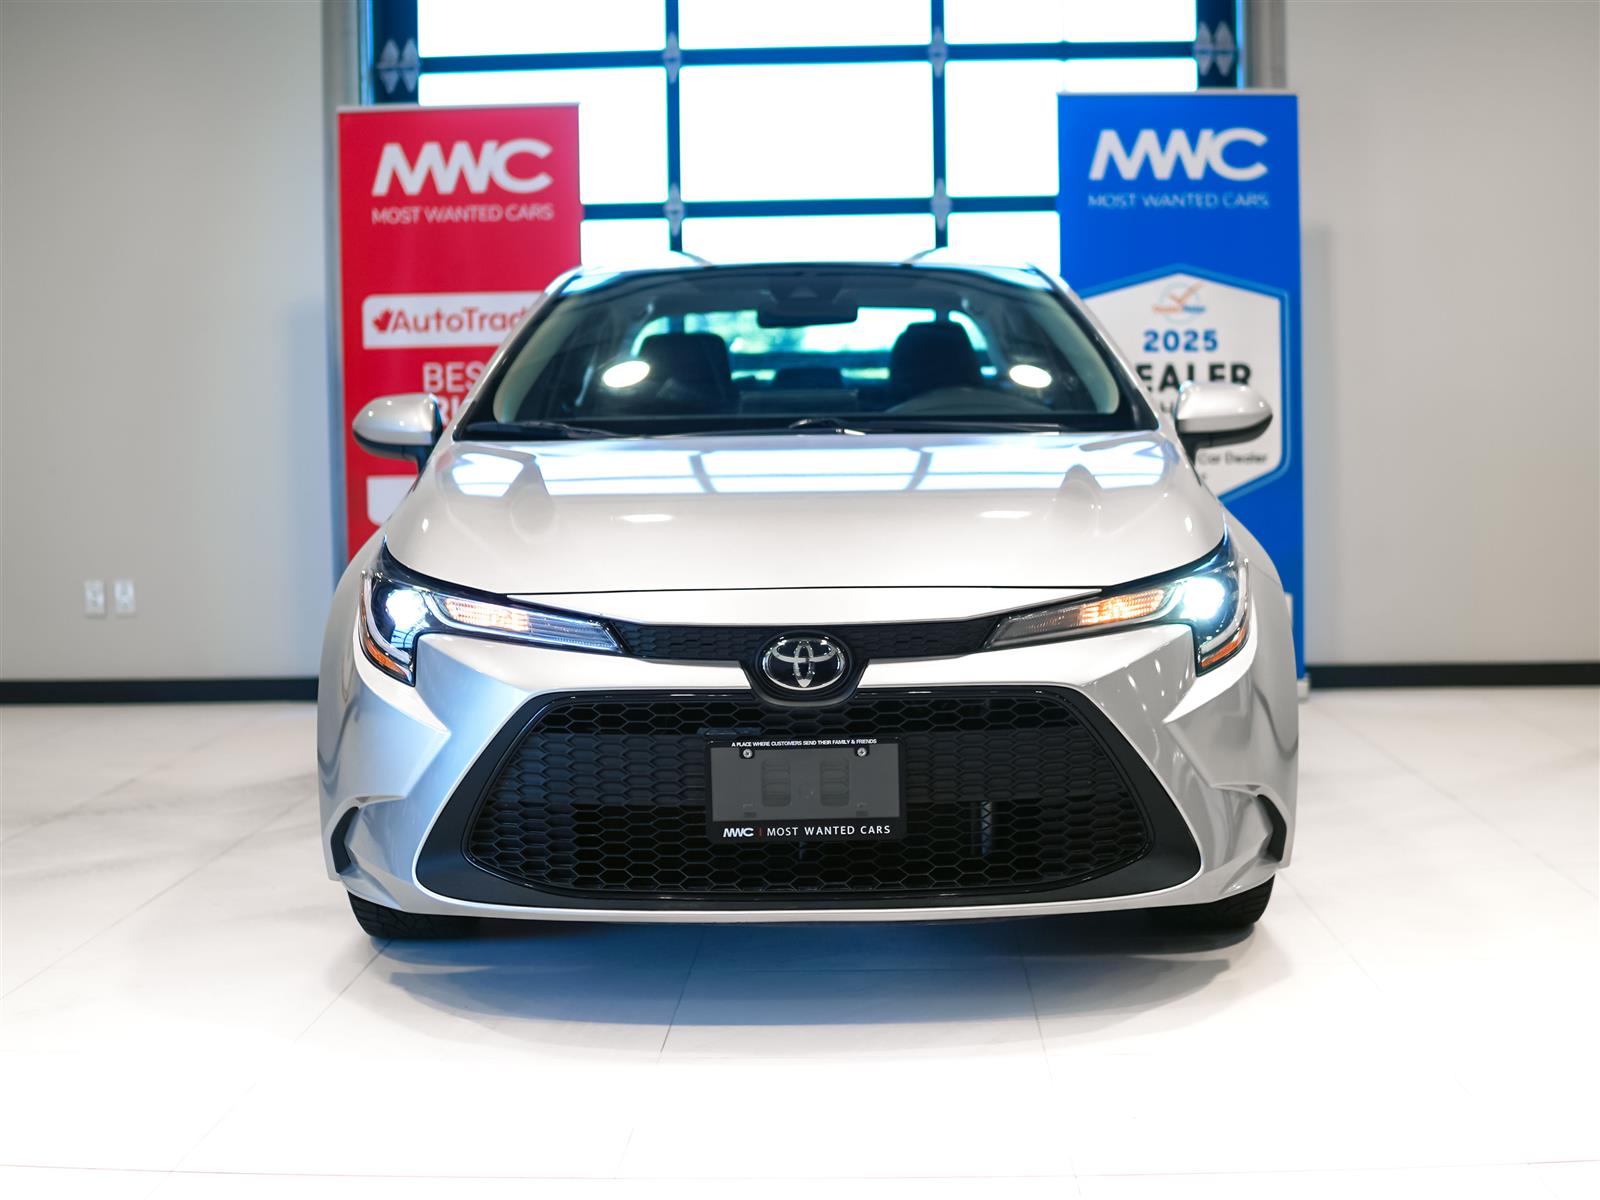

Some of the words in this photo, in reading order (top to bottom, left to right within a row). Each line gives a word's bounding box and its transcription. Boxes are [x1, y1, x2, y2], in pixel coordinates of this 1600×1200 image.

[1088, 127, 1268, 181] MWC
[371, 138, 553, 196] MWC
[1088, 192, 1135, 208] MOST
[1143, 192, 1218, 208] WANTED
[1222, 192, 1269, 208] CARS
[371, 206, 421, 224] MOST
[424, 204, 503, 223] WANTED
[505, 203, 554, 221] CARS
[1143, 329, 1219, 353] 2025
[722, 827, 754, 838] MWC
[767, 826, 798, 836] MOST
[804, 826, 855, 836] WANTED
[860, 825, 891, 835] CARS
